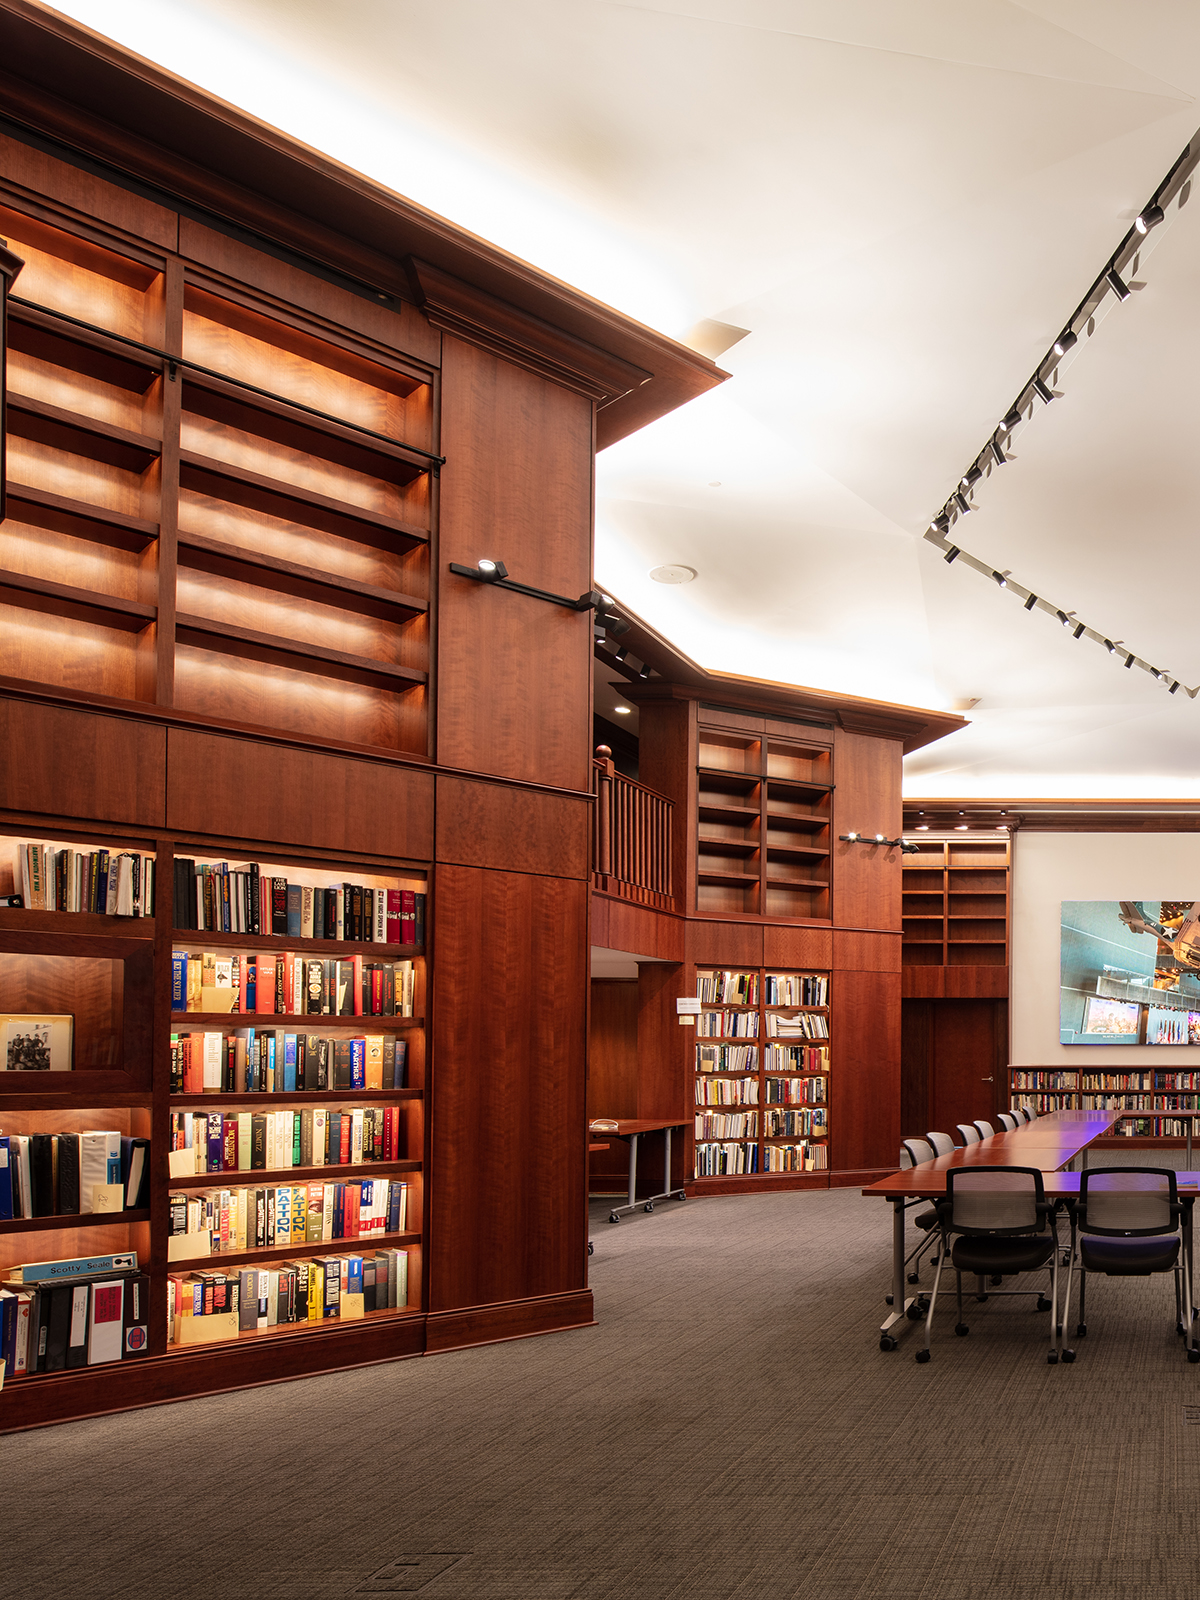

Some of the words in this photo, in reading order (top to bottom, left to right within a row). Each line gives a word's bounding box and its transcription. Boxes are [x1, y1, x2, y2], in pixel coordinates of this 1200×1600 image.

[173, 981, 182, 1001] SOLDIER
[208, 1034, 219, 1063] Churchill
[255, 1128, 263, 1152] NIMITZ
[277, 1188, 290, 1233] PATTON
[221, 1209, 229, 1242] PATTON
[50, 1265, 81, 1275] Scotty
[87, 1261, 111, 1270] Seale
